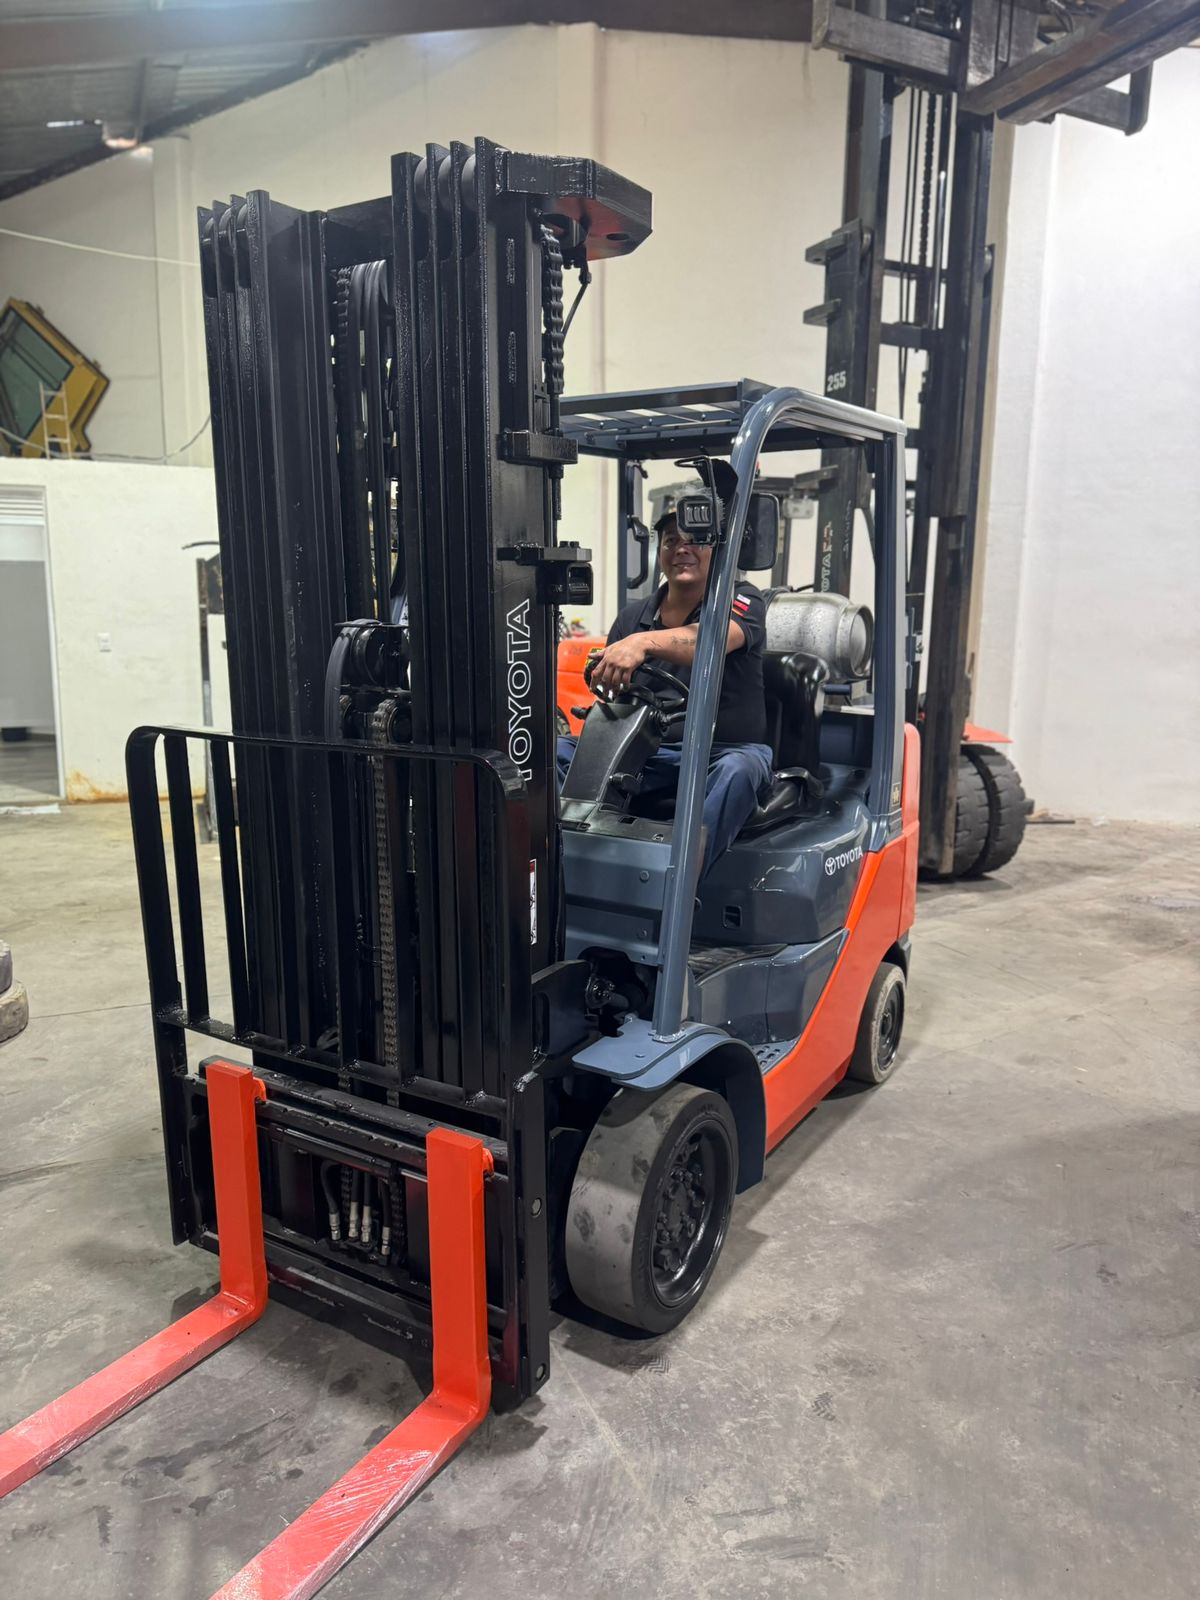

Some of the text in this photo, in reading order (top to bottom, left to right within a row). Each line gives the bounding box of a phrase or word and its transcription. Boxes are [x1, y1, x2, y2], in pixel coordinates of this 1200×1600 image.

[827, 370, 847, 392] 255
[821, 552, 832, 592] OTA
[835, 845, 864, 870] TOYOTA
